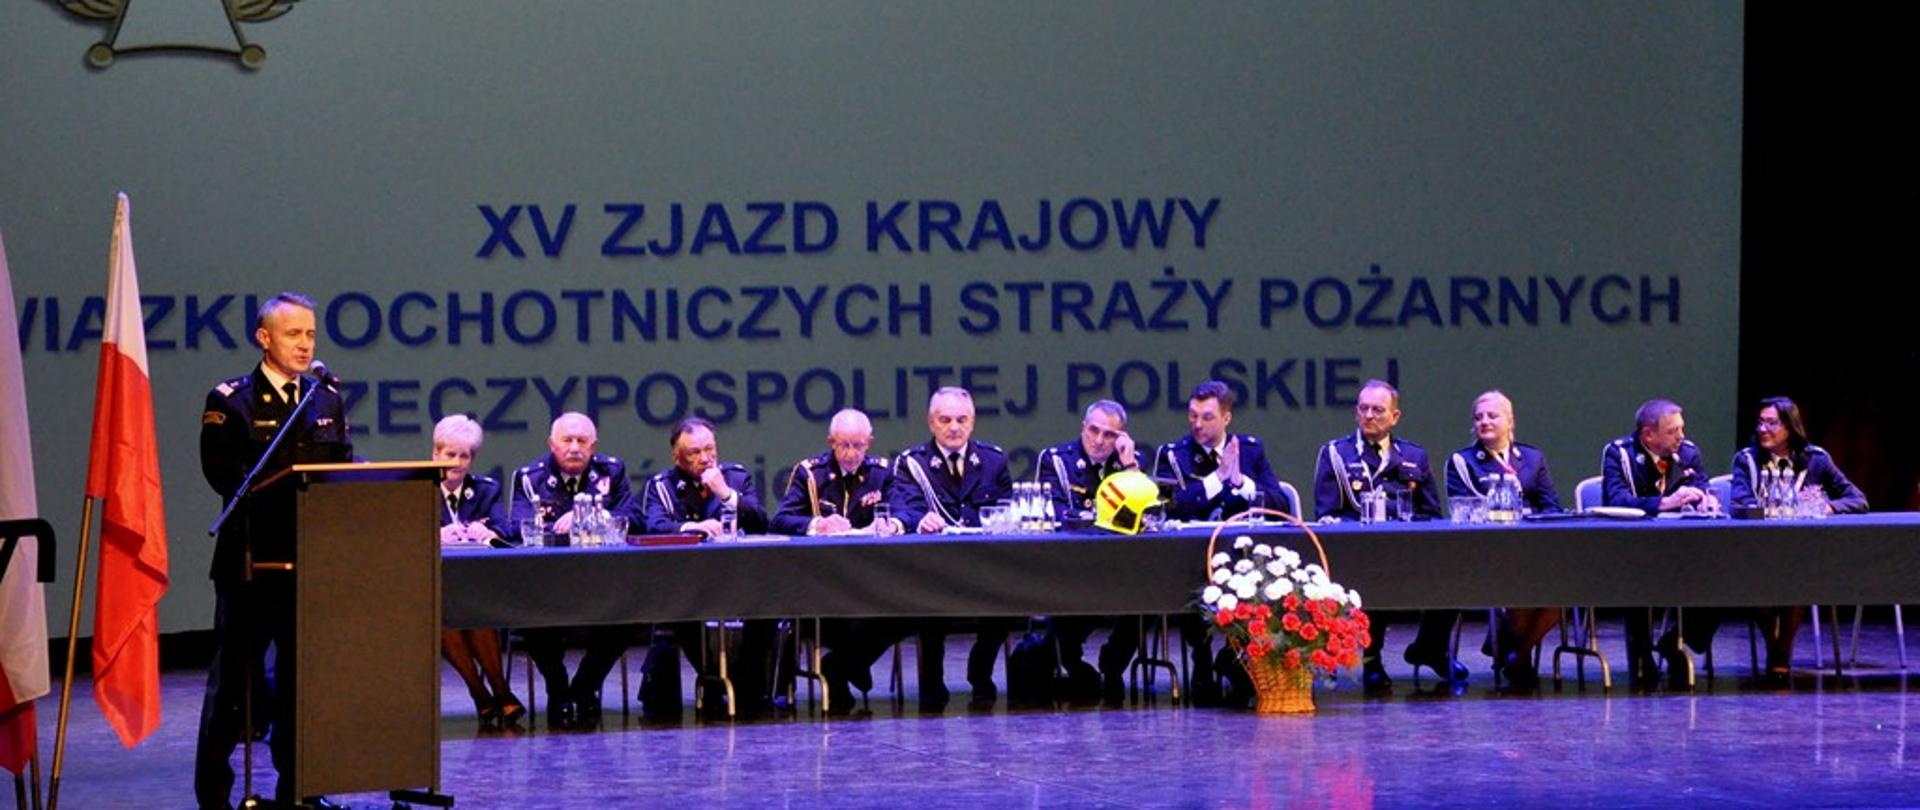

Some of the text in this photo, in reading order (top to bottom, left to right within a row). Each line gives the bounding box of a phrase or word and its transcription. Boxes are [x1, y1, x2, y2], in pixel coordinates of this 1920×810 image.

[476, 198, 1218, 259] XV ZJAZD KRAJOWY
[324, 283, 933, 351] OCHOTNICZYCH
[958, 265, 1233, 336] STRAŻY
[1258, 264, 1681, 329] POŻARNYCH
[342, 363, 1039, 437] ZECZYPOSPOLITEJ
